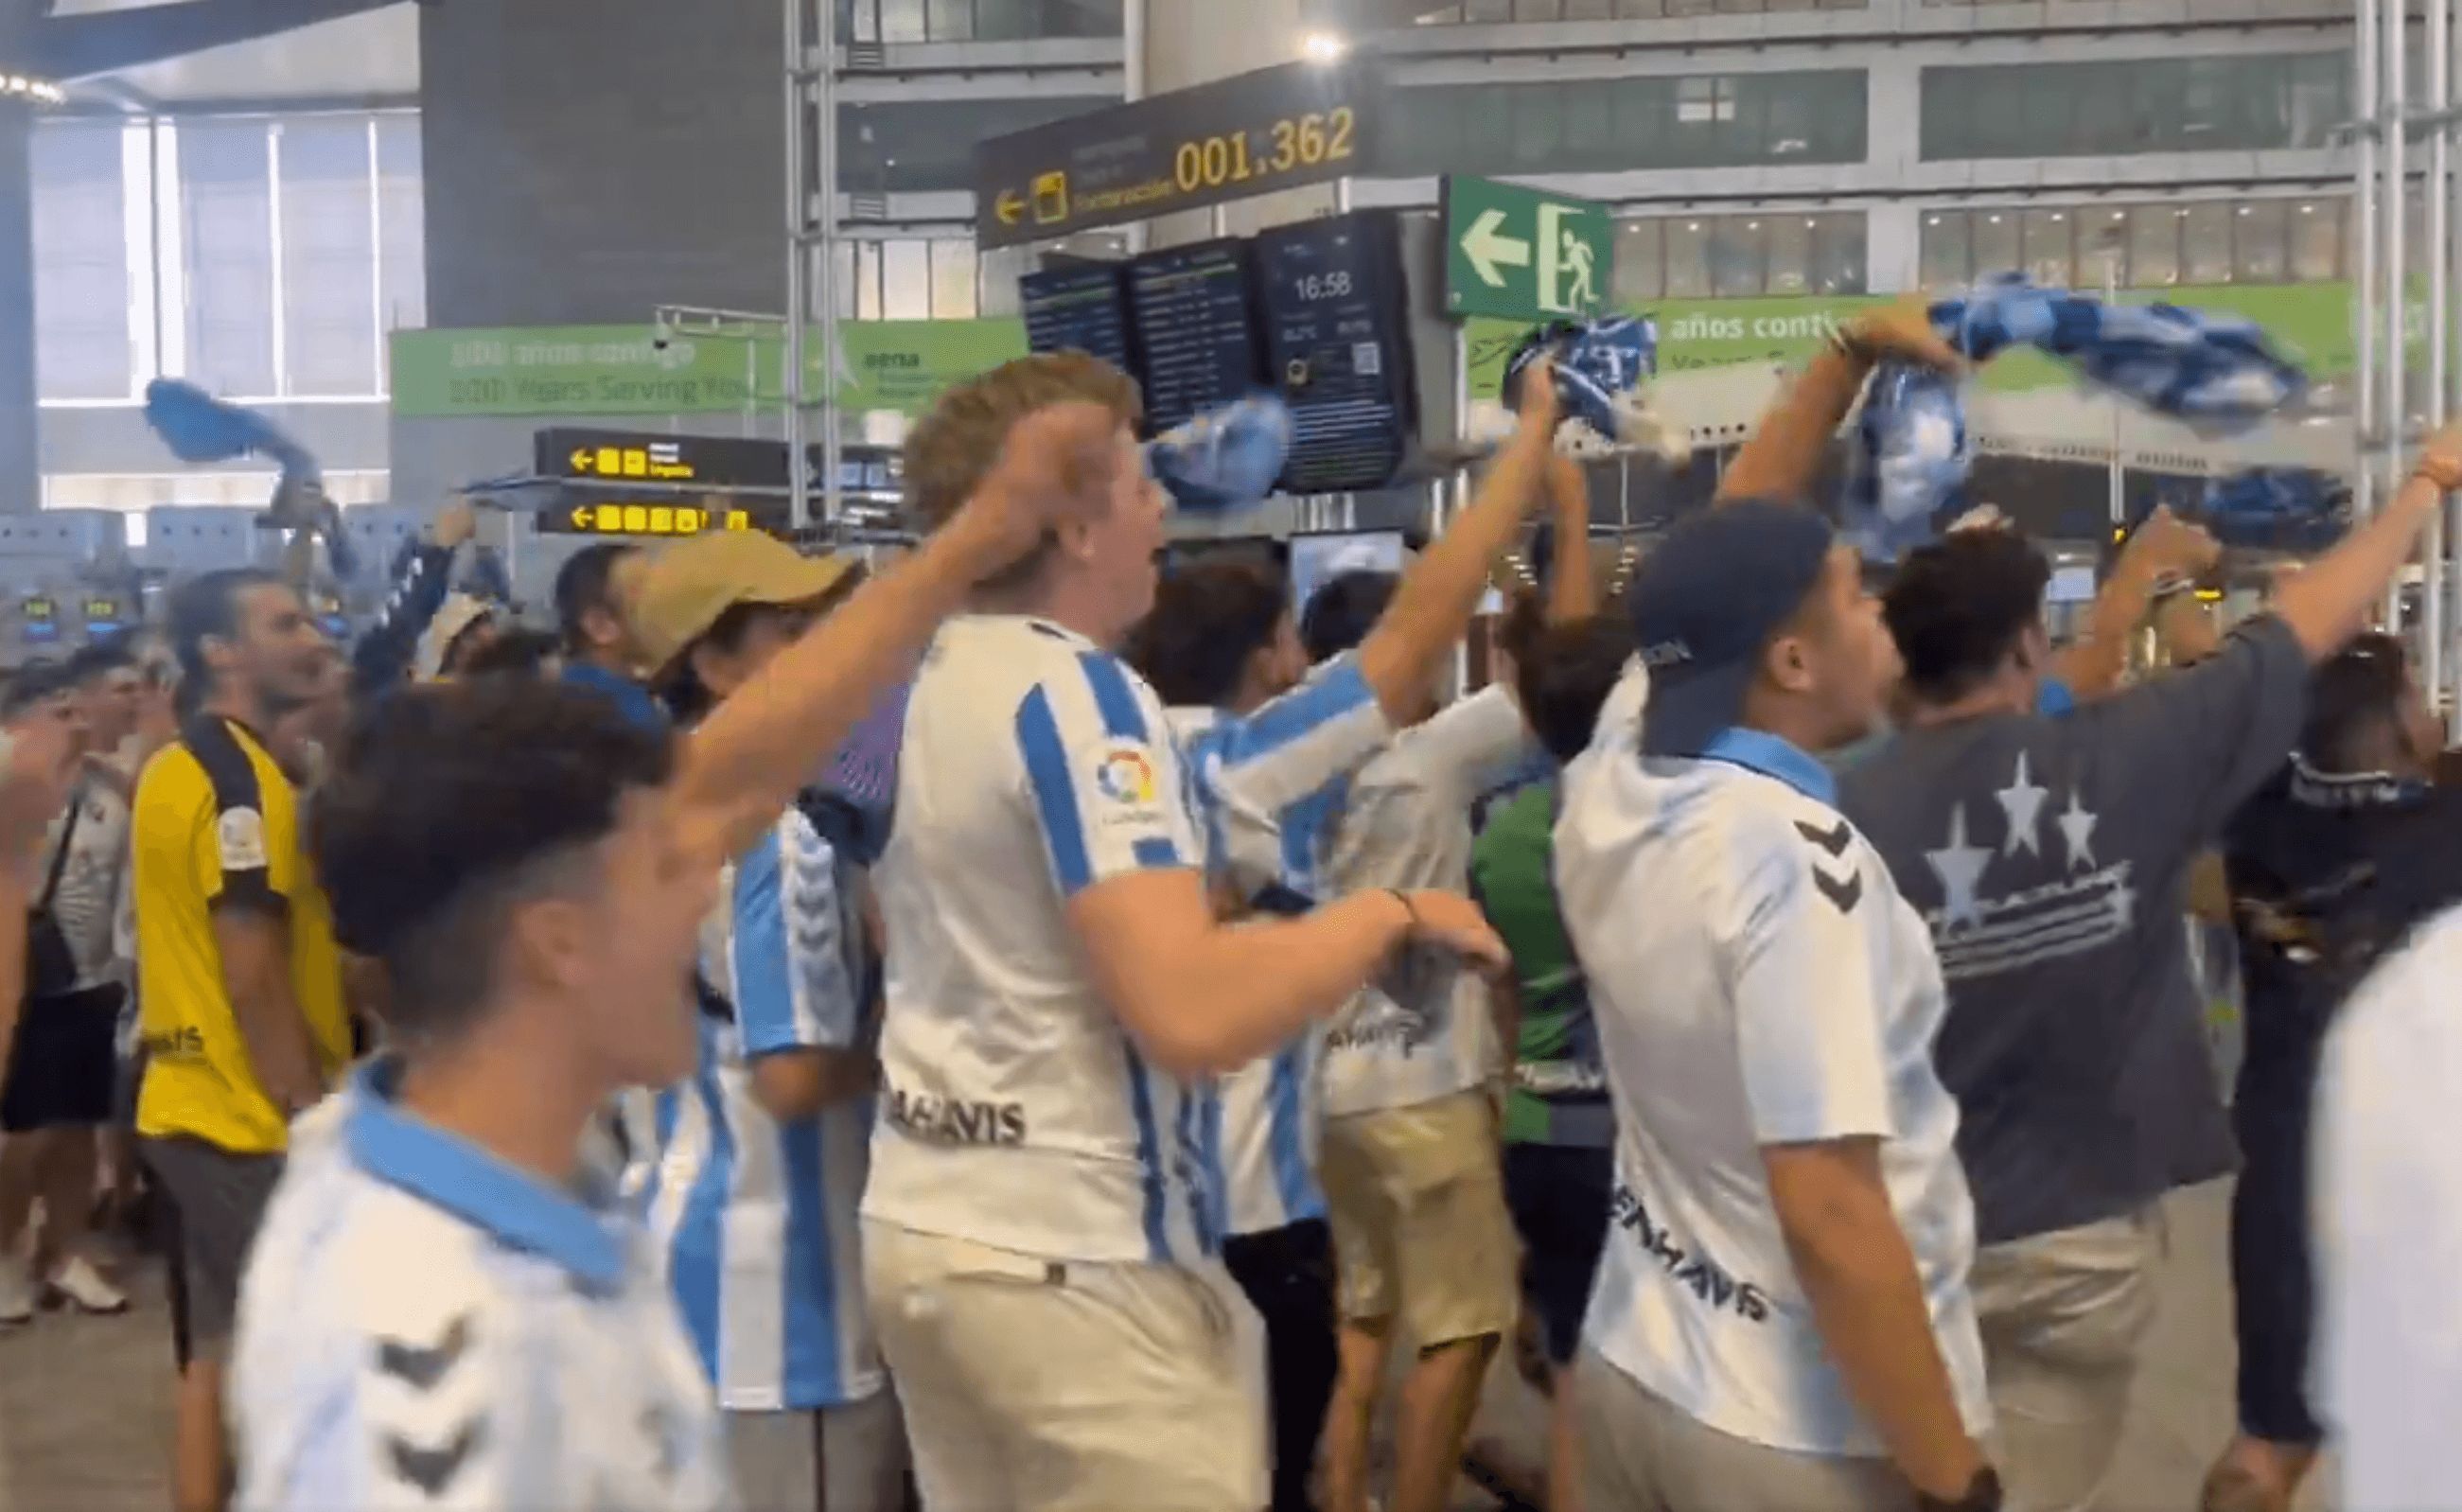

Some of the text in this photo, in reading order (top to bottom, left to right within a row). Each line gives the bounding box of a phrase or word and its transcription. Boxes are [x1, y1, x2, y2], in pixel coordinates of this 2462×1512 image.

[1175, 107, 1354, 193] 001.362
[1294, 272, 1352, 301] 16:58
[1670, 312, 1745, 339] años
